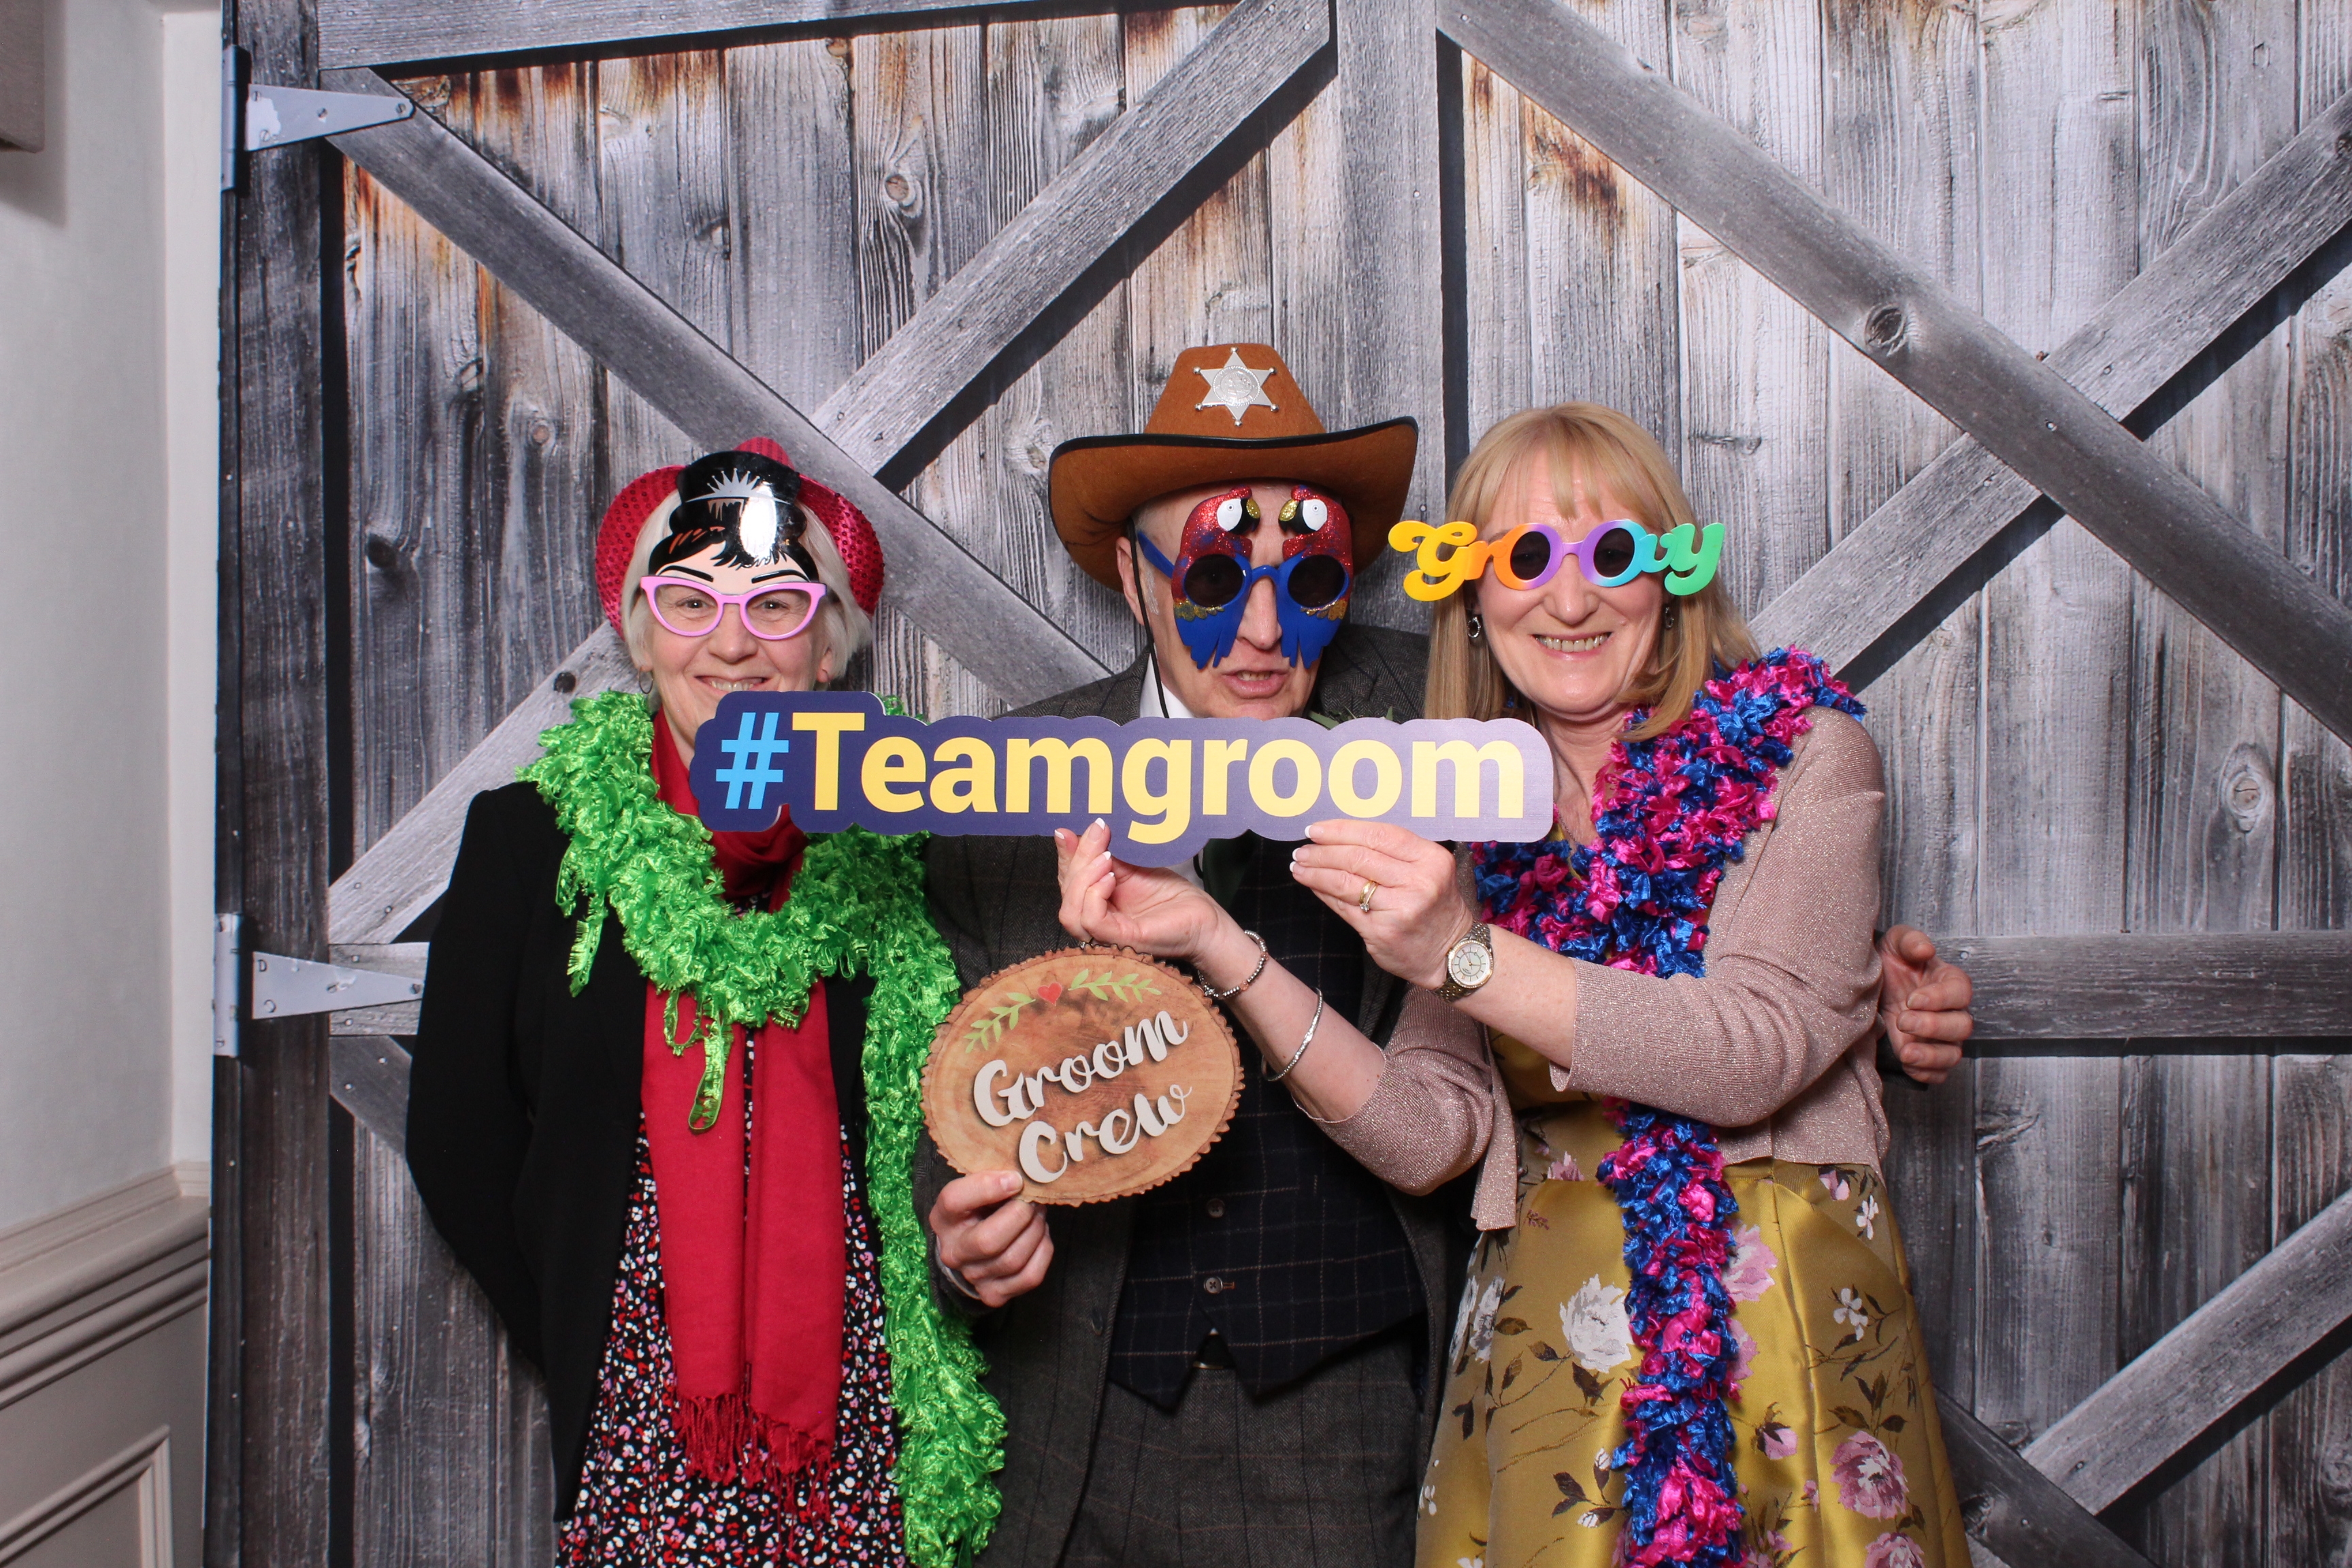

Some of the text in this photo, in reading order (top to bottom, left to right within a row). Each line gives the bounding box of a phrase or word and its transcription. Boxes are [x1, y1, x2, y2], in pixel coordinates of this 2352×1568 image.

[715, 711, 1524, 844] #Teamgroom
[973, 1010, 1189, 1127] Groom
[1019, 1083, 1193, 1183] Crew
